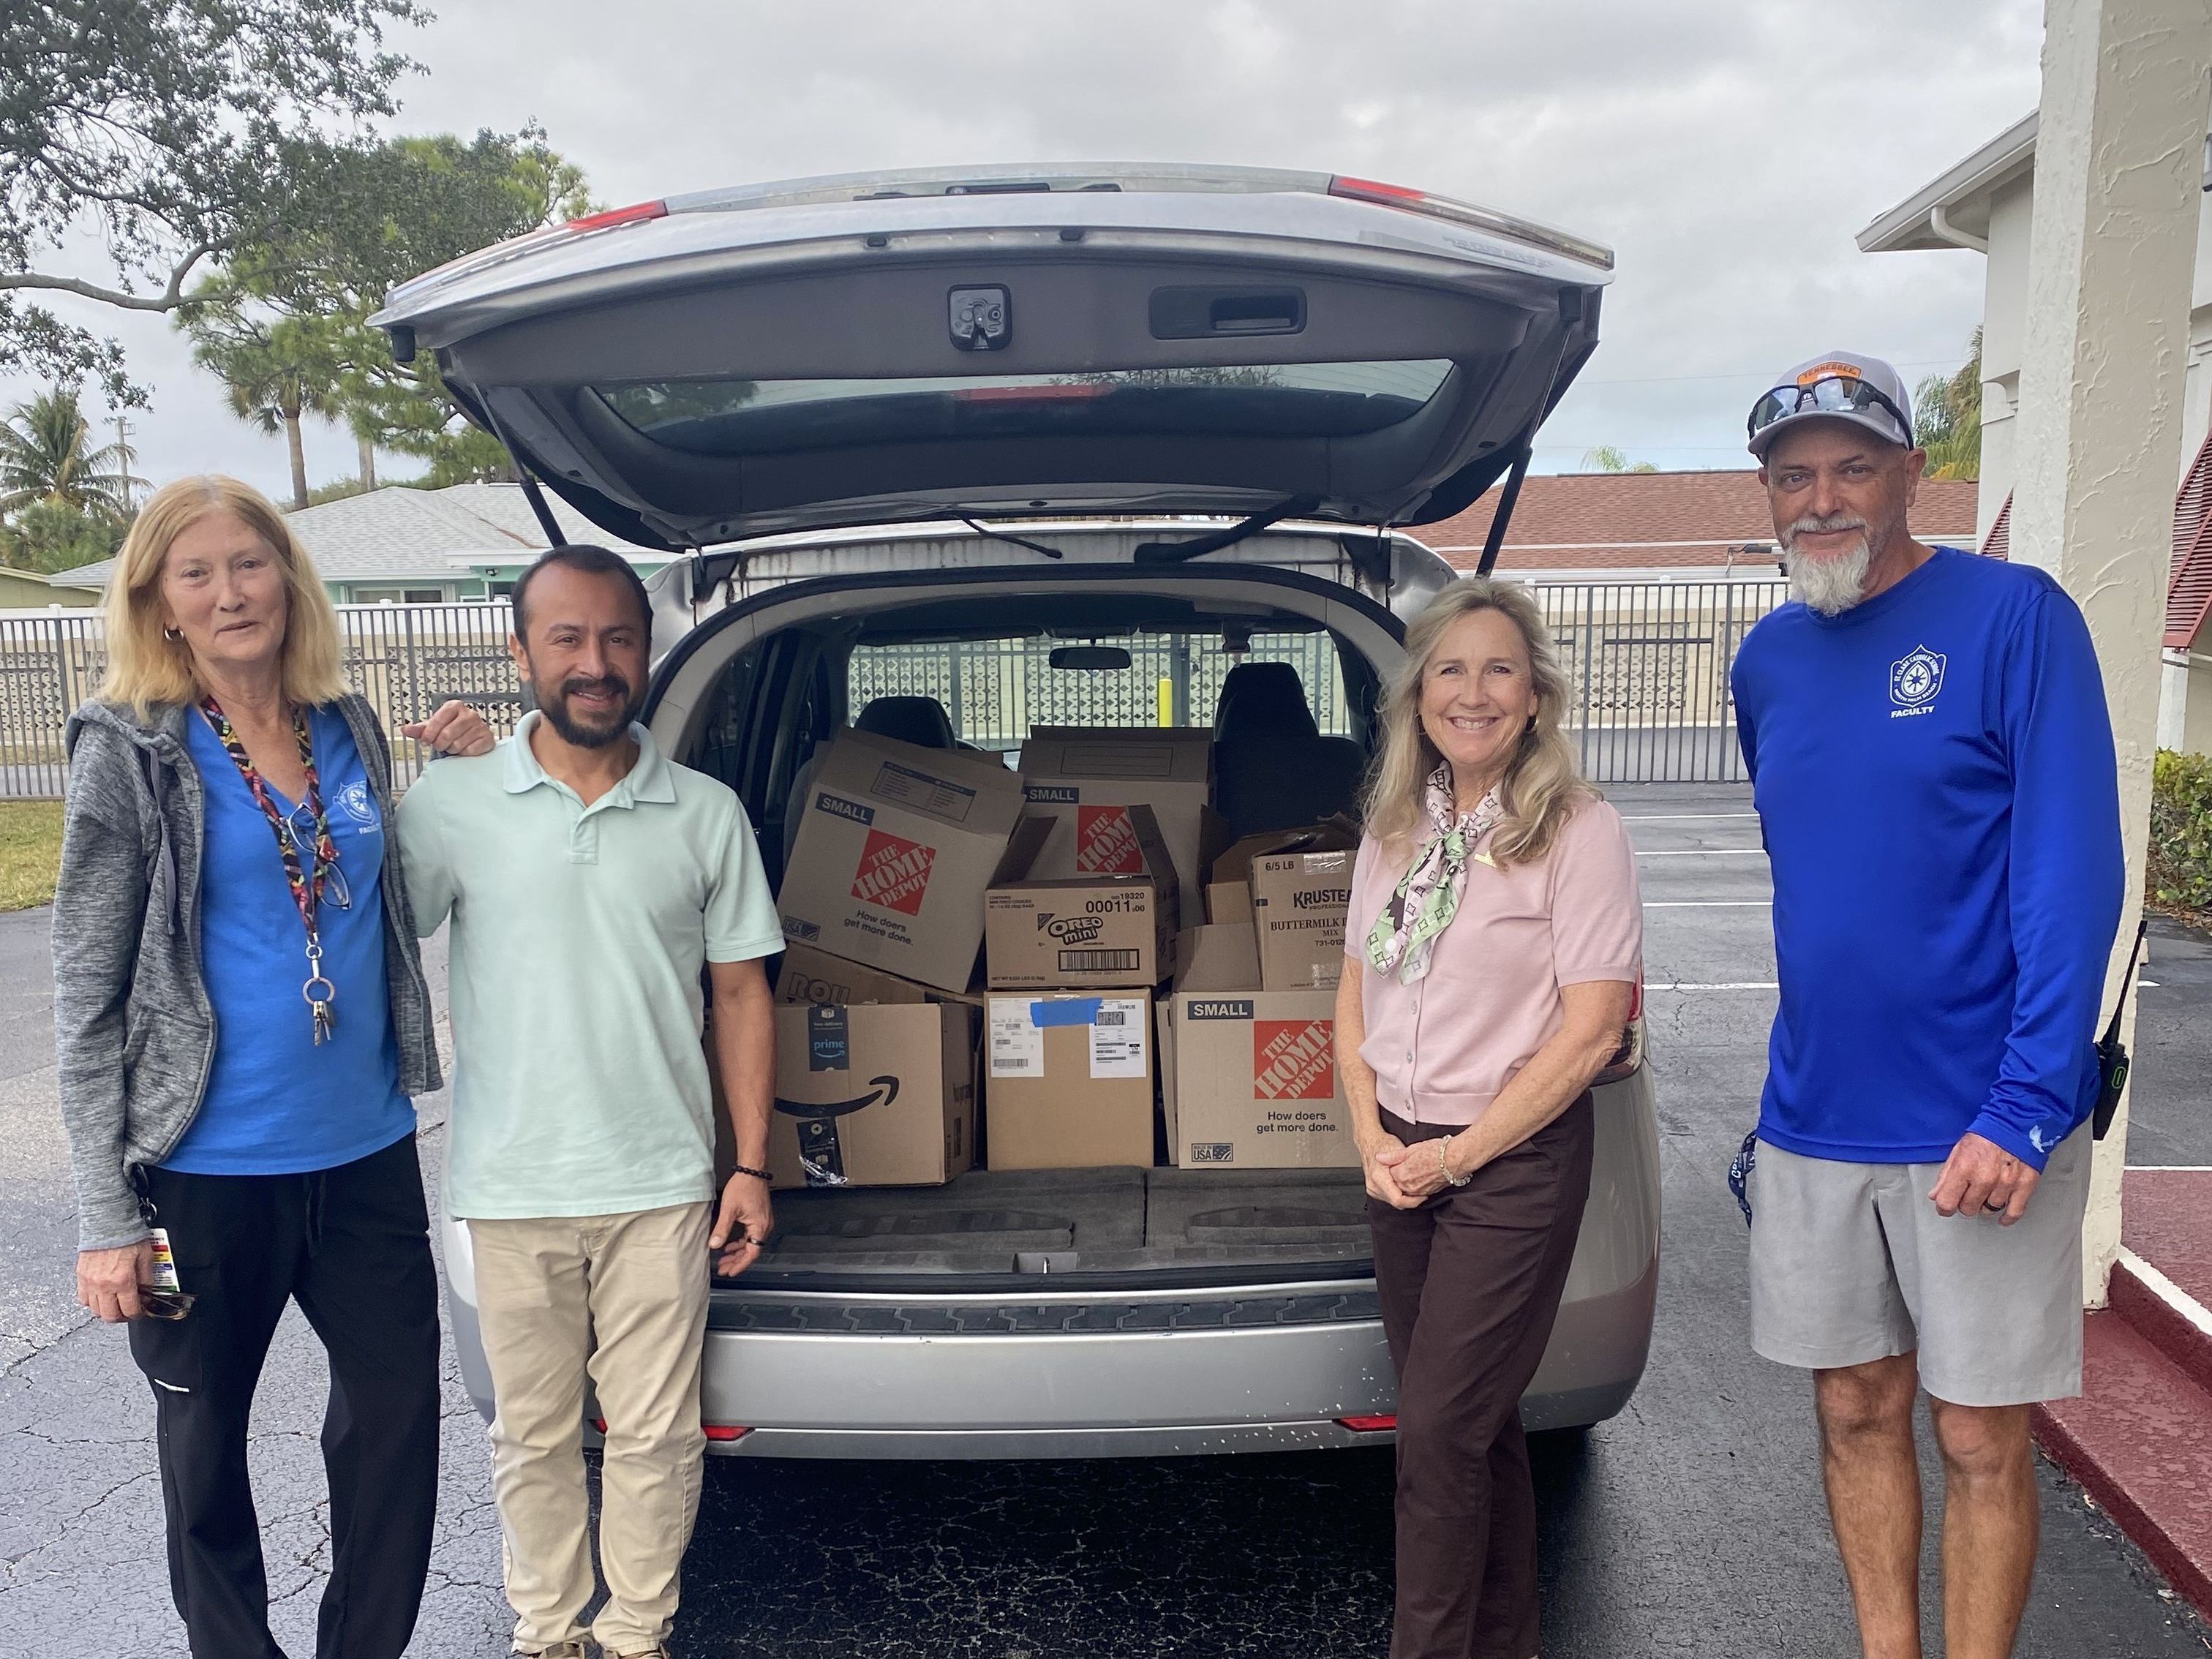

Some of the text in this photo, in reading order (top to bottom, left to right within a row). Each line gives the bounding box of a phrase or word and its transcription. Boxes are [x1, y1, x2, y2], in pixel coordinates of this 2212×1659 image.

[1803, 364, 1856, 378] TENNESSEE
[1891, 705, 1935, 718] FACULTY
[1029, 789, 1075, 801] SMALL
[821, 797, 868, 821] SMALL
[1084, 813, 1113, 840] THE
[1077, 812, 1134, 872] HOM
[868, 843, 900, 868] THE
[1103, 837, 1137, 872] DEPO
[854, 846, 933, 900] HOME
[1265, 860, 1295, 871] 6/5 LB
[879, 873, 928, 907] DEPOT
[857, 909, 907, 933] How doers
[1049, 917, 1103, 936] OREO
[1271, 917, 1341, 930] BUTTERMILK
[844, 918, 914, 946] get more done.
[1064, 928, 1096, 944] mini
[1323, 929, 1339, 937] MIX
[1193, 1003, 1248, 1016] SMALL
[814, 1039, 845, 1050] prime
[1261, 1028, 1295, 1061] THE
[1254, 1020, 1334, 1099] HOME
[1285, 1049, 1334, 1099] DEPOT
[1268, 1110, 1327, 1121] How doers
[1257, 1123, 1338, 1134] get more done.
[1194, 1149, 1212, 1160] USA
